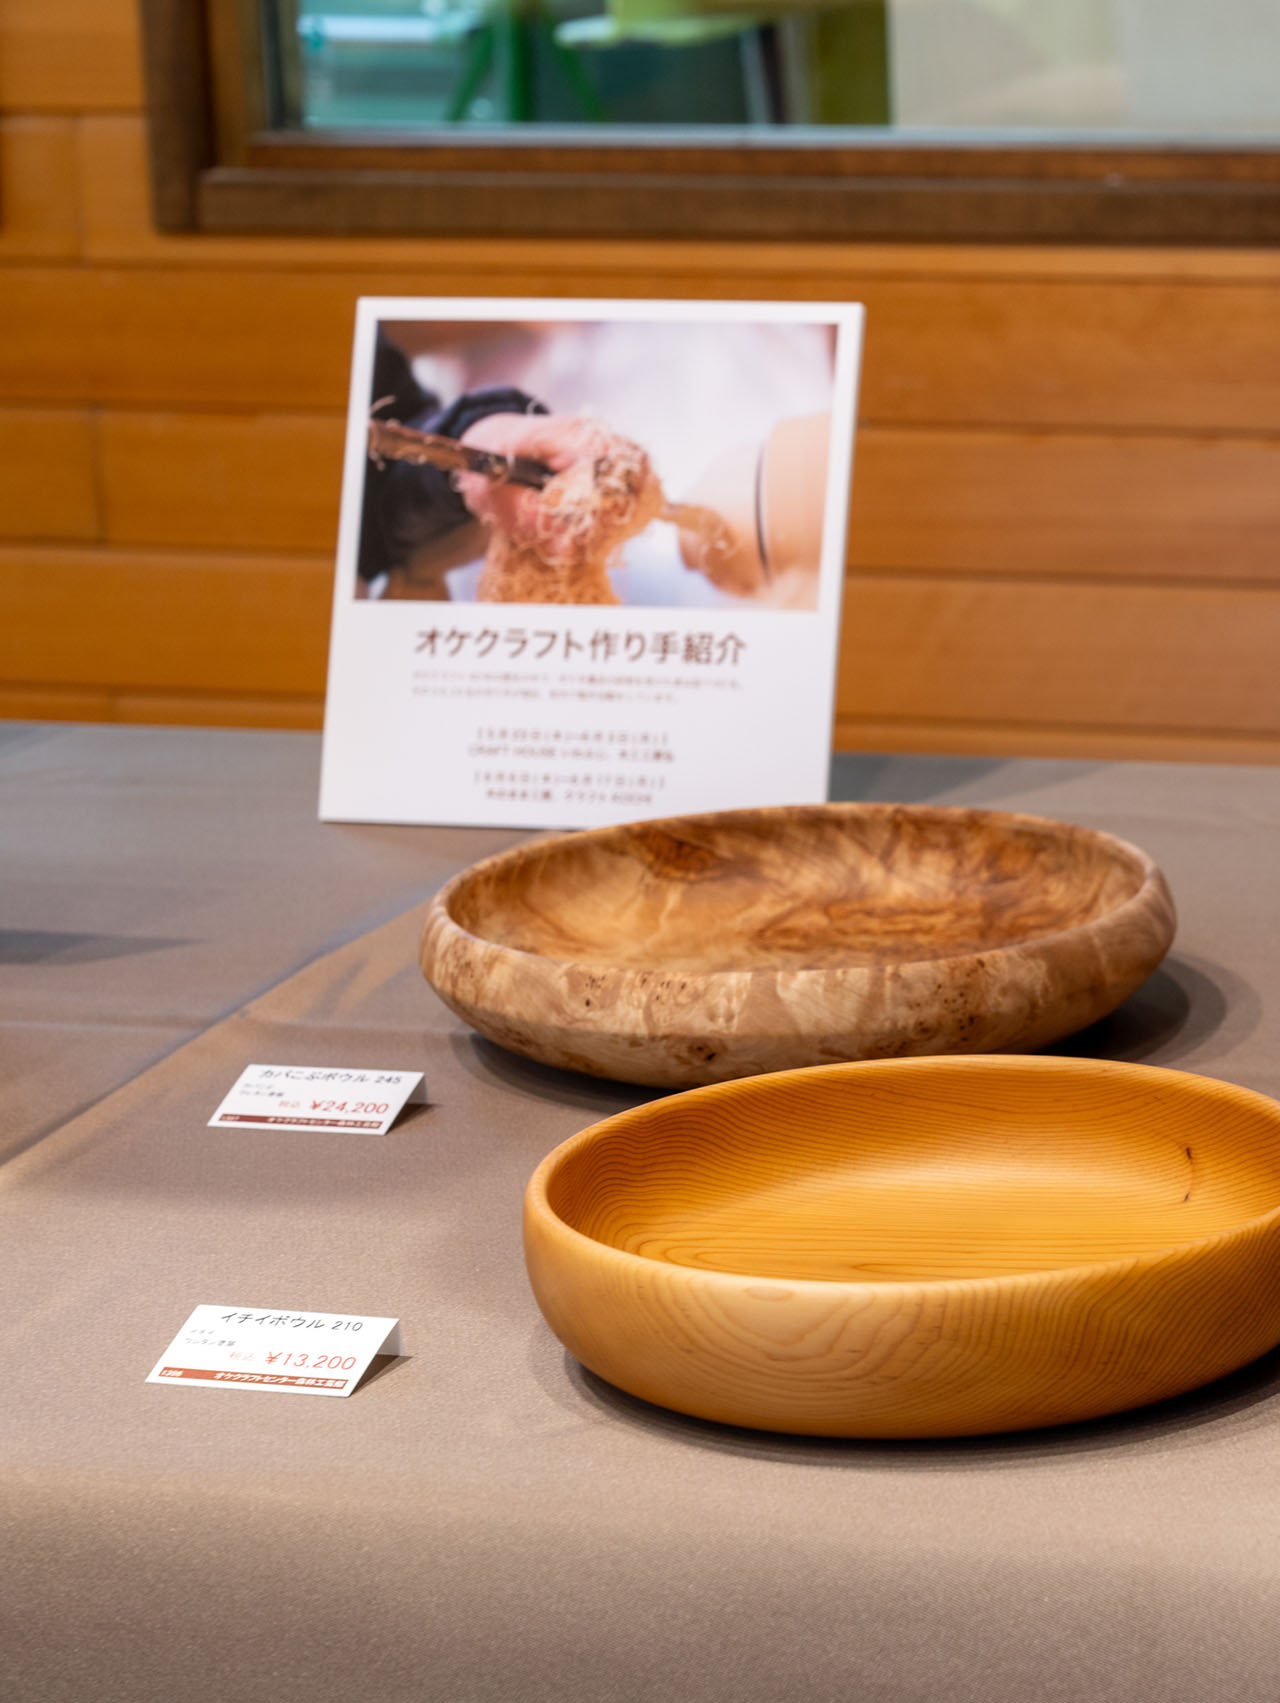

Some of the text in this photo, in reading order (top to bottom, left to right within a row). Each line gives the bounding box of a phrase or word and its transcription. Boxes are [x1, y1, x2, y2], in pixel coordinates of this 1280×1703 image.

[414, 626, 747, 666] オケクラフト作り手紹介
[309, 1099, 389, 1114] ¥24,200
[220, 1312, 364, 1332] イチイボウル 210
[264, 1351, 358, 1371] ¥13,200
